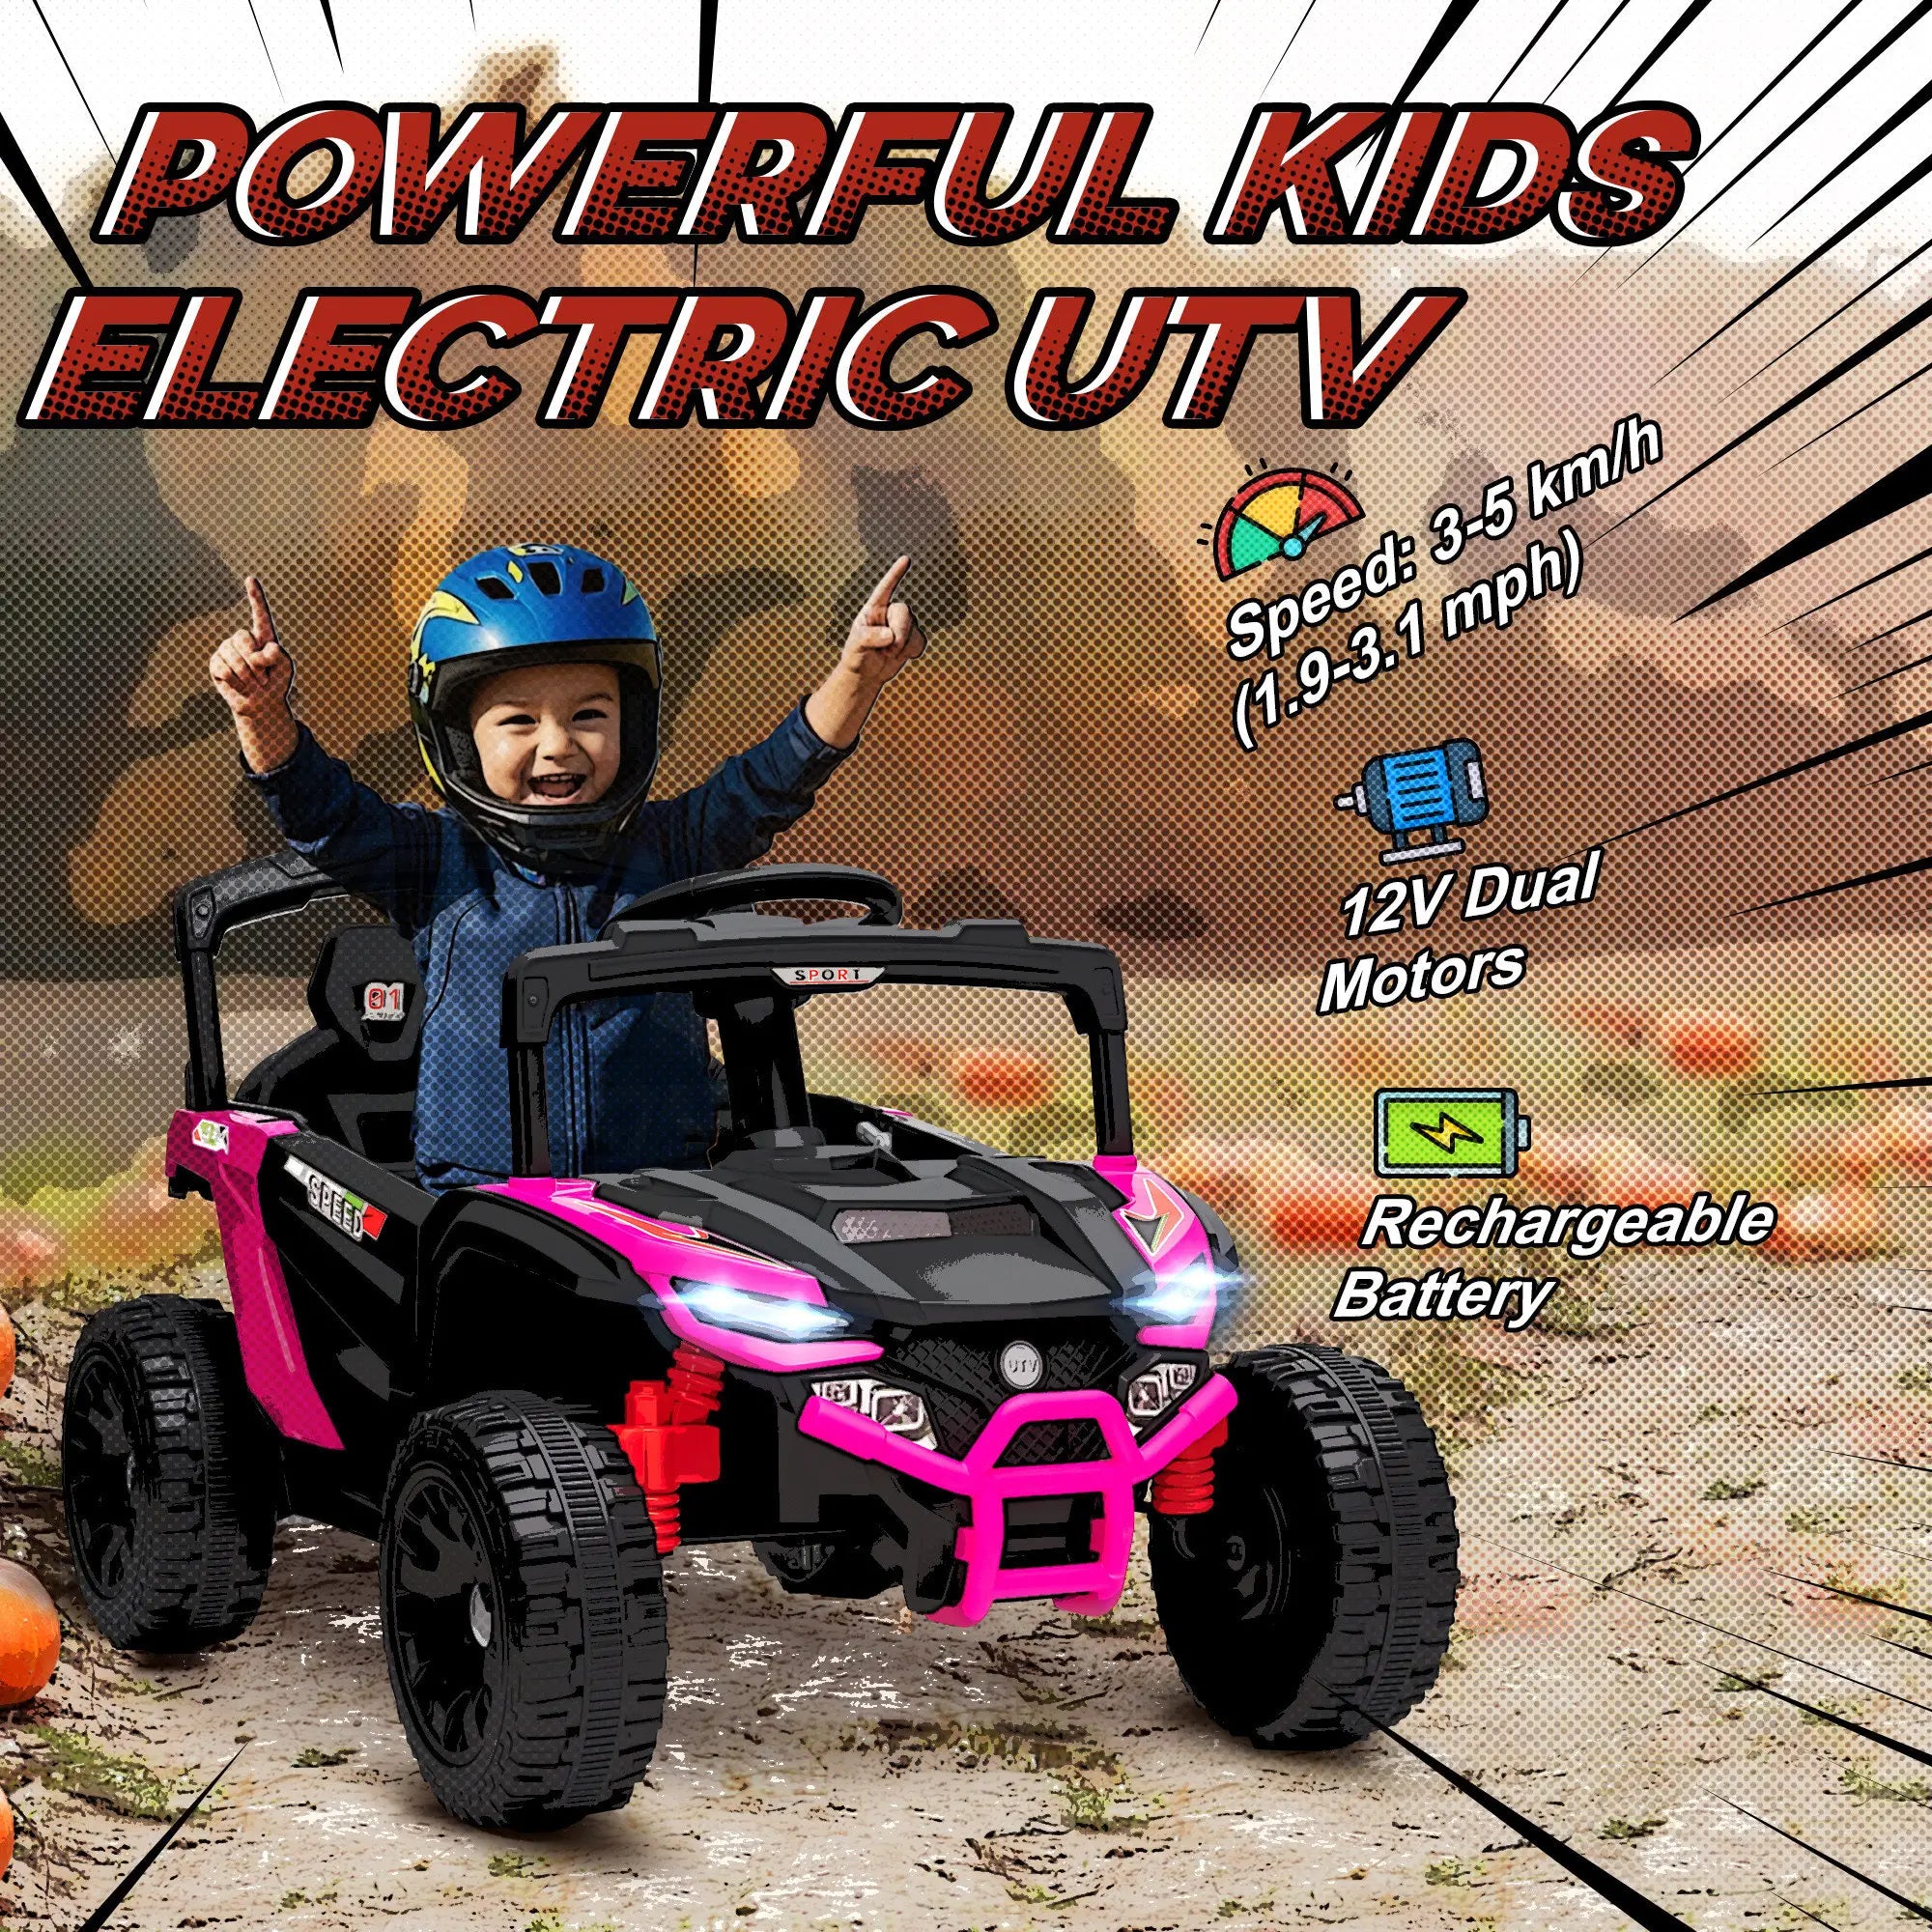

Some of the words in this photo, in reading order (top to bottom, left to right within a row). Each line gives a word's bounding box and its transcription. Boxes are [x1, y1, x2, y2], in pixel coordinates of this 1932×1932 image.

[793, 967, 862, 981] SPORT
[366, 986, 402, 1011] 01
[307, 1172, 364, 1239] SPEED
[1009, 1358, 1038, 1374] UTV
